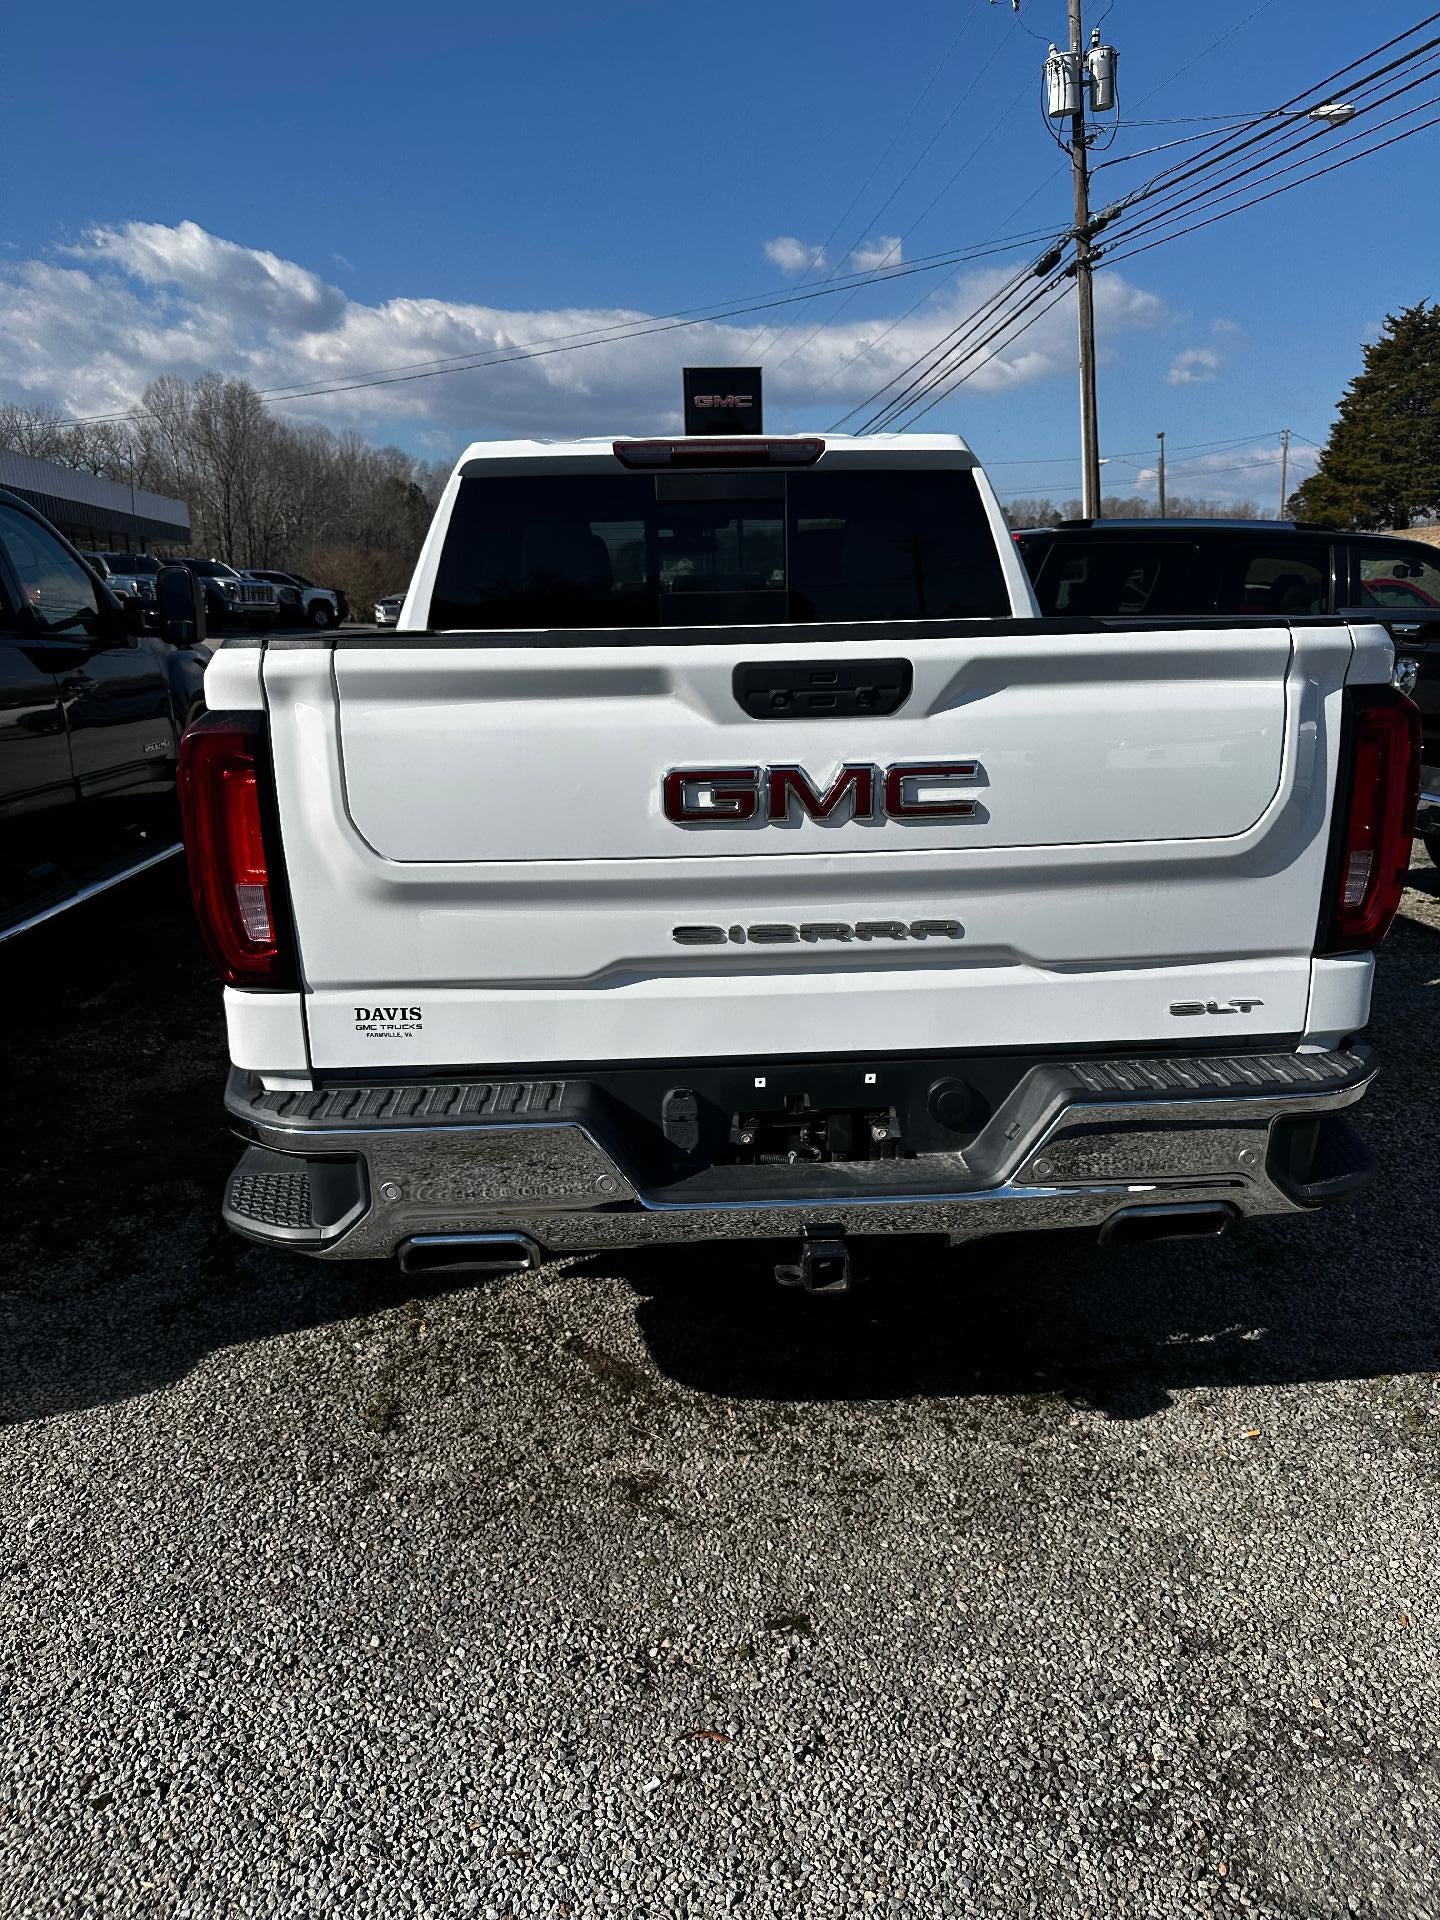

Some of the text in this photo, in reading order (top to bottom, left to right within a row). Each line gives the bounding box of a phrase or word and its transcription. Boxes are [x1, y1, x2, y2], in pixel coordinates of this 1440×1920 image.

[694, 395, 753, 408] GMC
[662, 760, 979, 823] GMC
[672, 919, 964, 945] SIERRA
[354, 1007, 422, 1021] DAVIS
[1169, 1000, 1264, 1017] SLT
